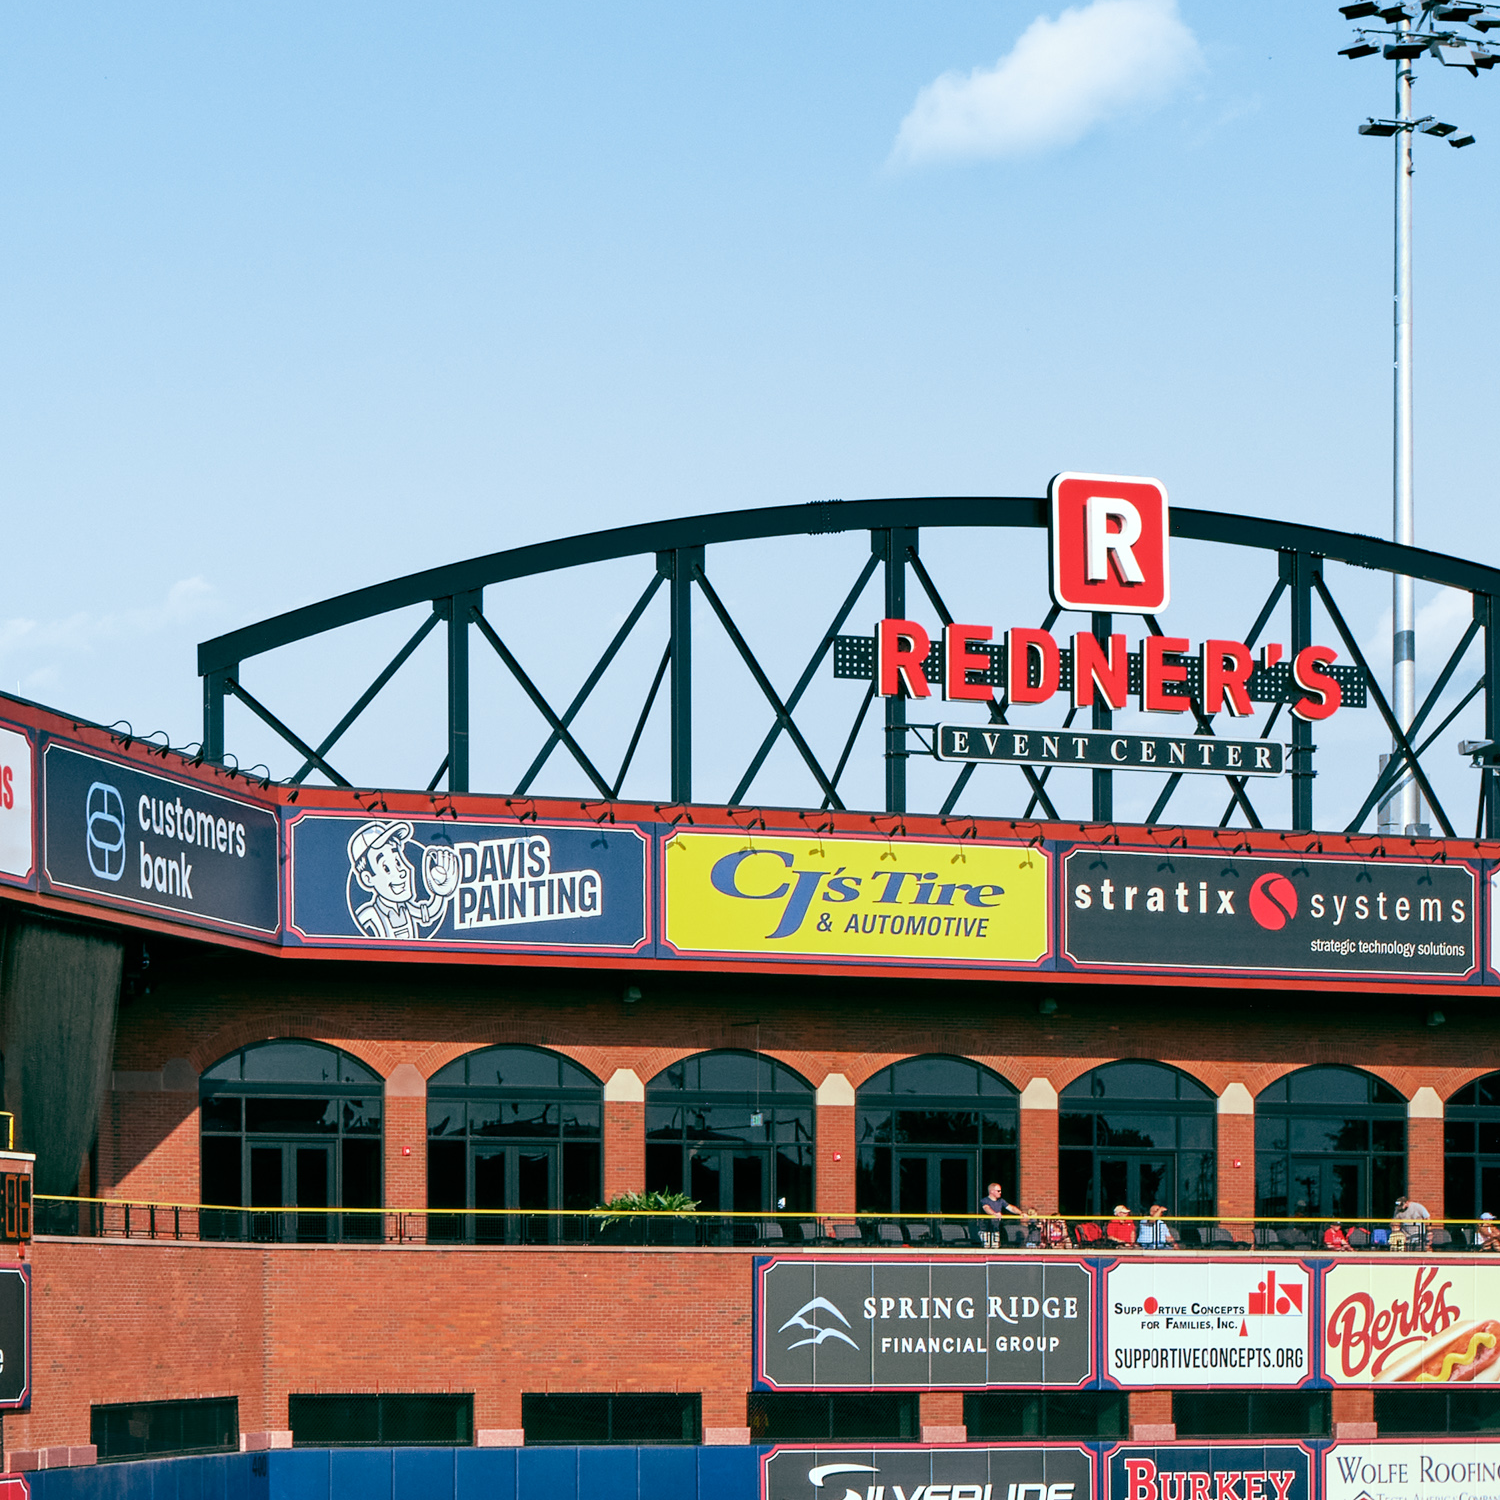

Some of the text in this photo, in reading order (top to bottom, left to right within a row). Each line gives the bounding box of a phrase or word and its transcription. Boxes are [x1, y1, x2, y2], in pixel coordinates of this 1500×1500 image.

[1083, 496, 1145, 586] R
[875, 619, 1341, 721] REDNER'S
[952, 731, 1272, 770] EVENT CENTER
[138, 794, 247, 858] customers
[140, 842, 194, 900] bank
[460, 840, 549, 884] DAVIS
[458, 872, 599, 924] PAINTING
[868, 869, 1005, 908] Tire
[1075, 878, 1465, 925] stratix systems
[844, 915, 988, 938] AUTOMOTIVE
[1310, 938, 1464, 957] strategic technology solutions
[863, 1296, 1078, 1324] SPRING RIDGE
[1327, 1267, 1461, 1380] Berks
[882, 1336, 1060, 1354] FINANCIAL GROUP
[1114, 1347, 1303, 1369] SUPPORTIVECONCEPTS.ORG
[1336, 1456, 1408, 1484] WOLFE
